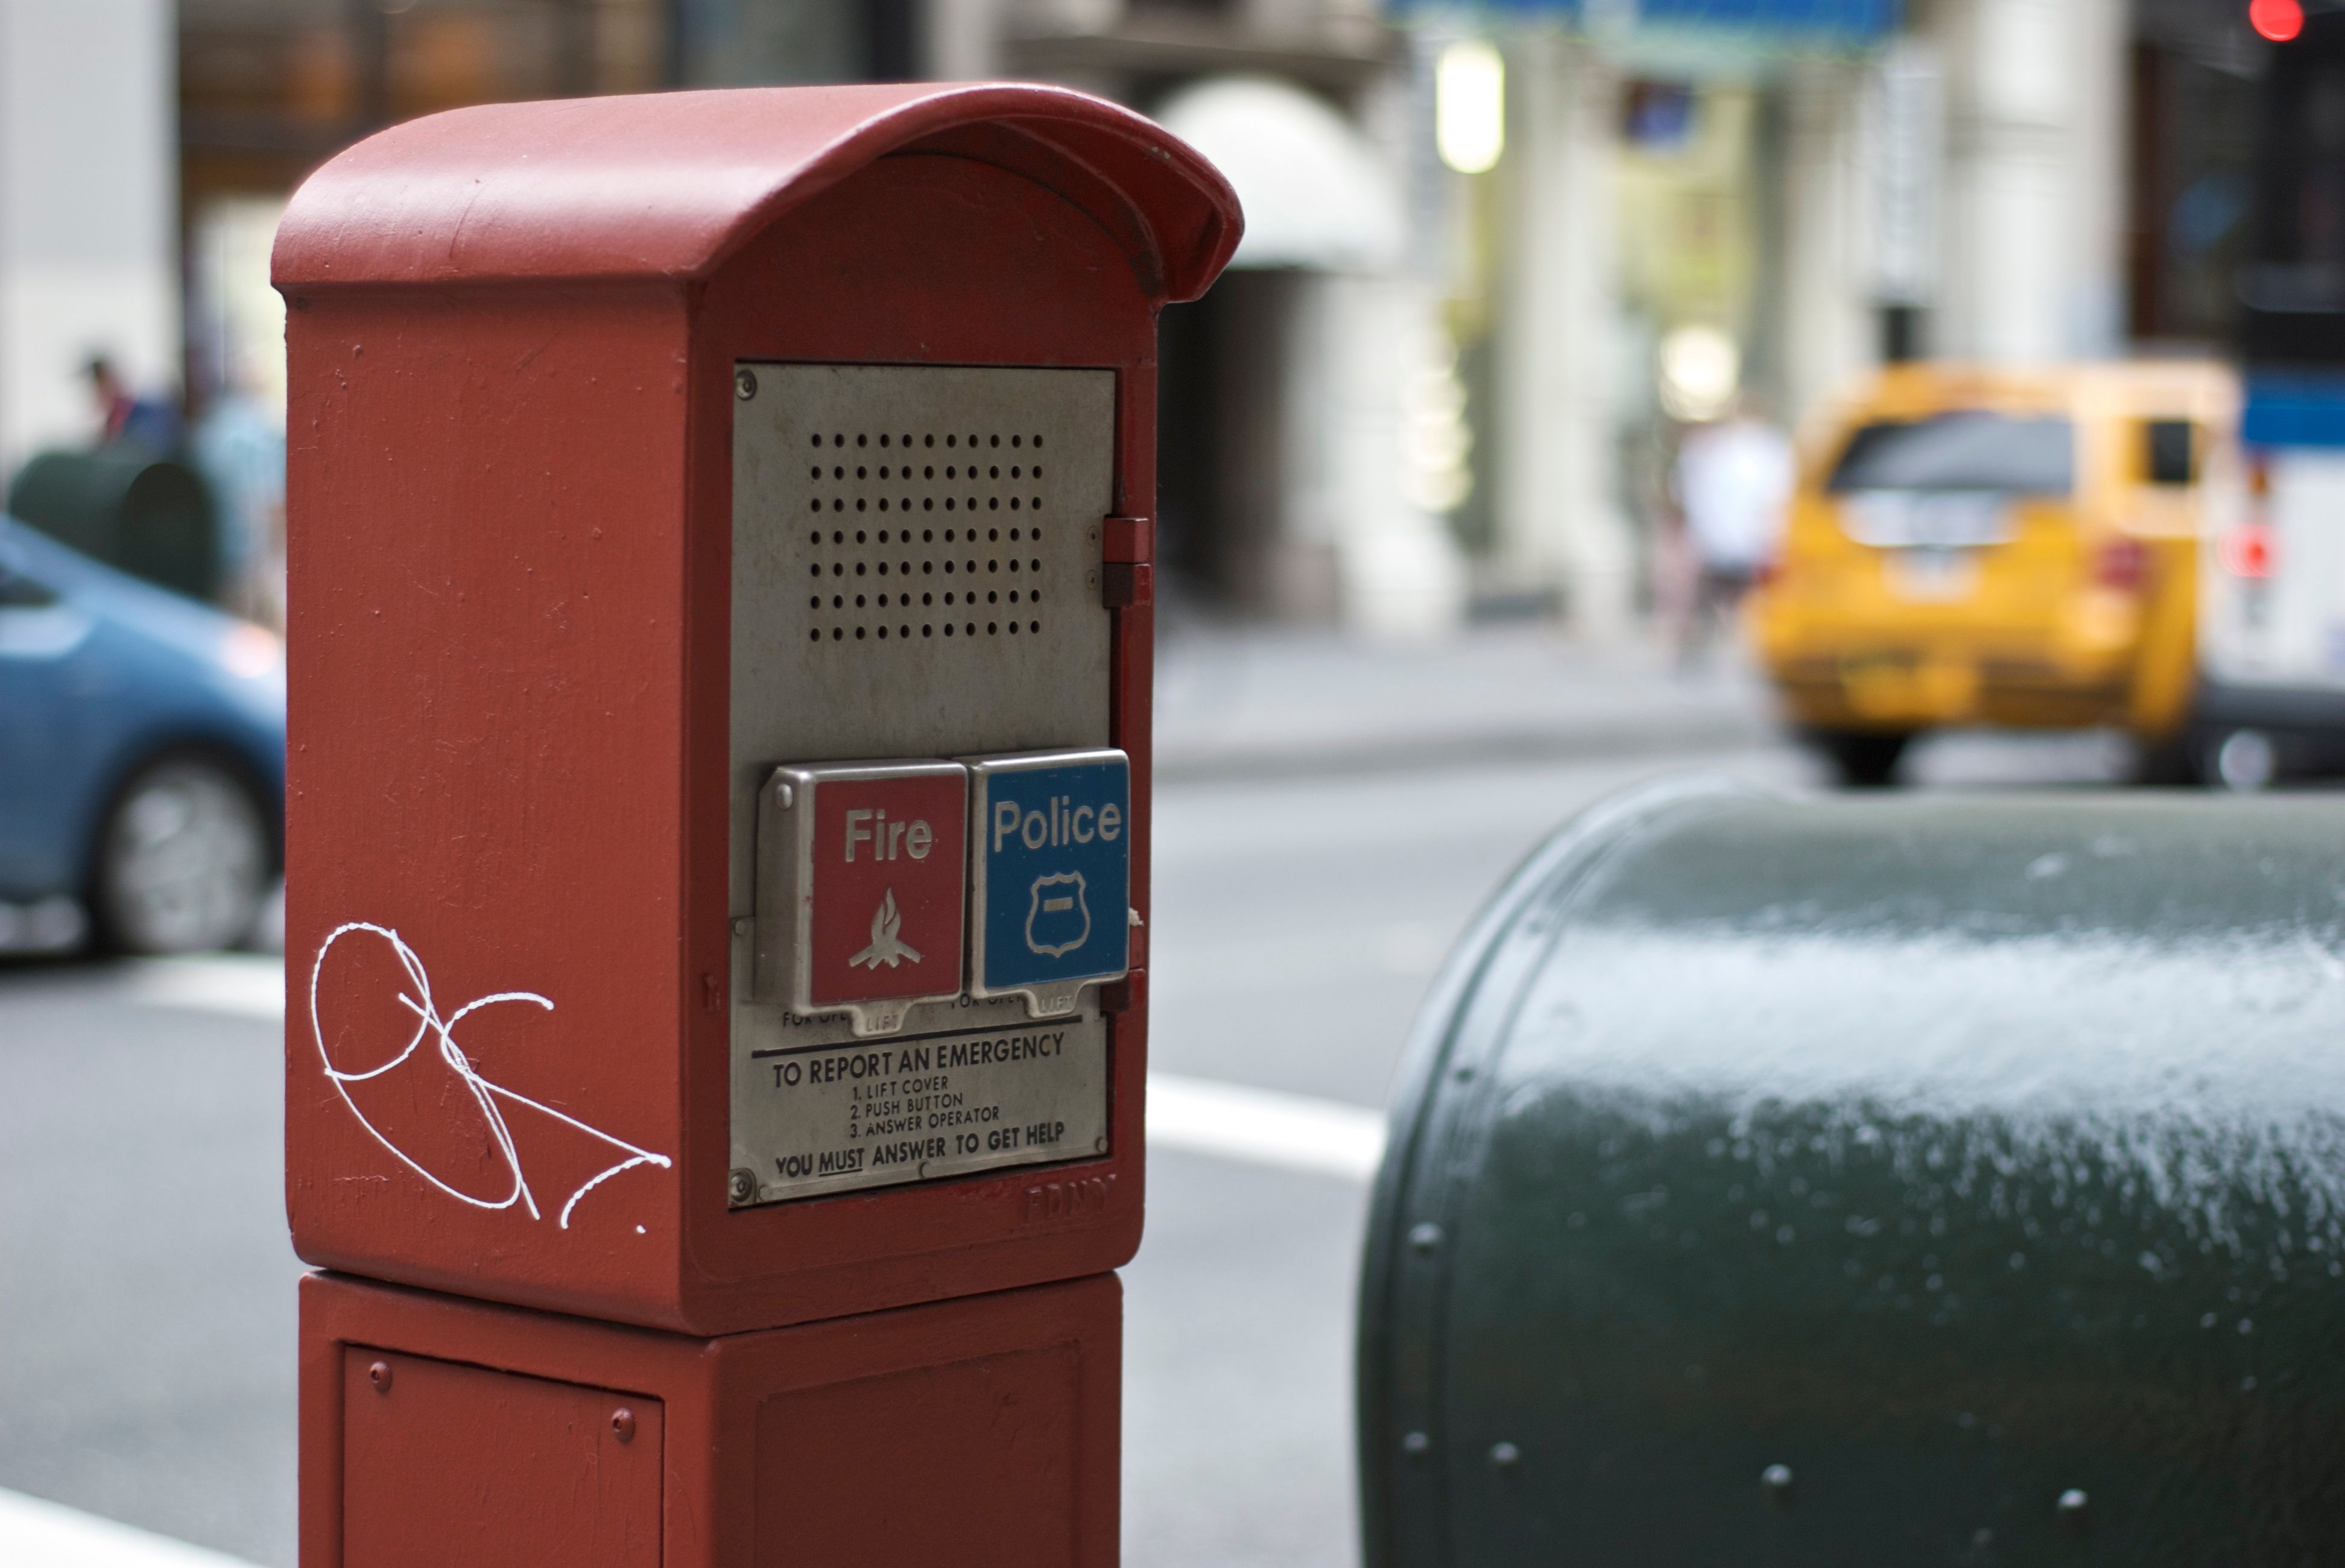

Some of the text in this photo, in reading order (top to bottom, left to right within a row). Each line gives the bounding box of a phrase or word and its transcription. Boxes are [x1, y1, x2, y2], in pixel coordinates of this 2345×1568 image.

[845, 809, 932, 863] Fire
[994, 795, 1121, 853] Police
[1039, 996, 1072, 1012] LIFT
[866, 1013, 899, 1032] LIFT
[773, 1032, 1065, 1088] TO REPORT AN EMERGENCY
[852, 1075, 948, 1101] 1. LIFT COVER
[850, 1092, 963, 1120] 2. PUSH BUTTON
[850, 1105, 999, 1139] 3. ANSWER OPERATOR
[776, 1121, 1065, 1177] YOU MUST ANSWER TO GET HELP
